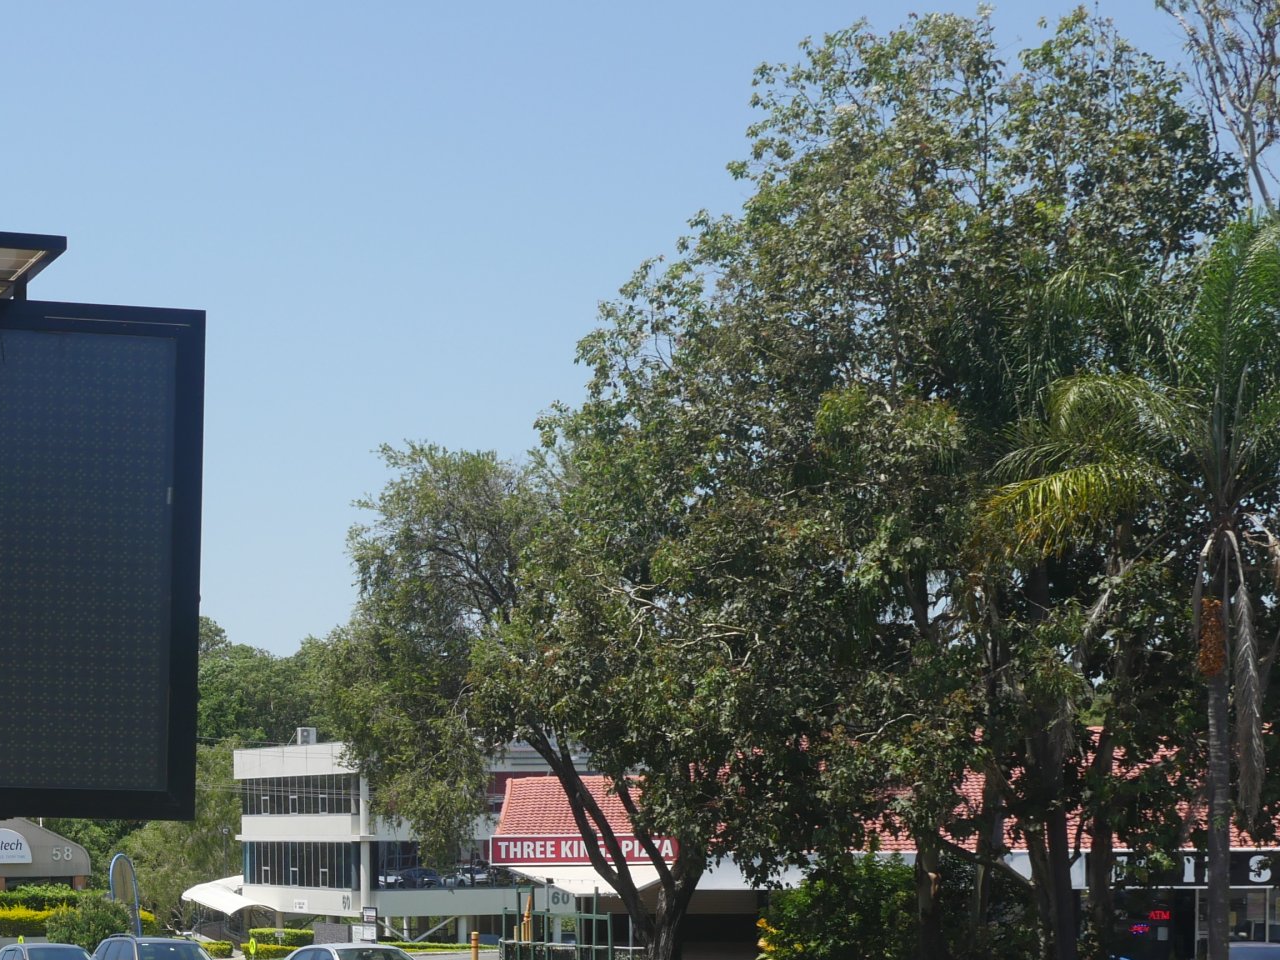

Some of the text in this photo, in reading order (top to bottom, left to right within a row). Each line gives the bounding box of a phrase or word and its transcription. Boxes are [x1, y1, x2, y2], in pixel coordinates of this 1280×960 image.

[52, 847, 73, 861] 58
[497, 841, 556, 859] THREE
[560, 840, 612, 859] KIN
[551, 891, 570, 905] 60
